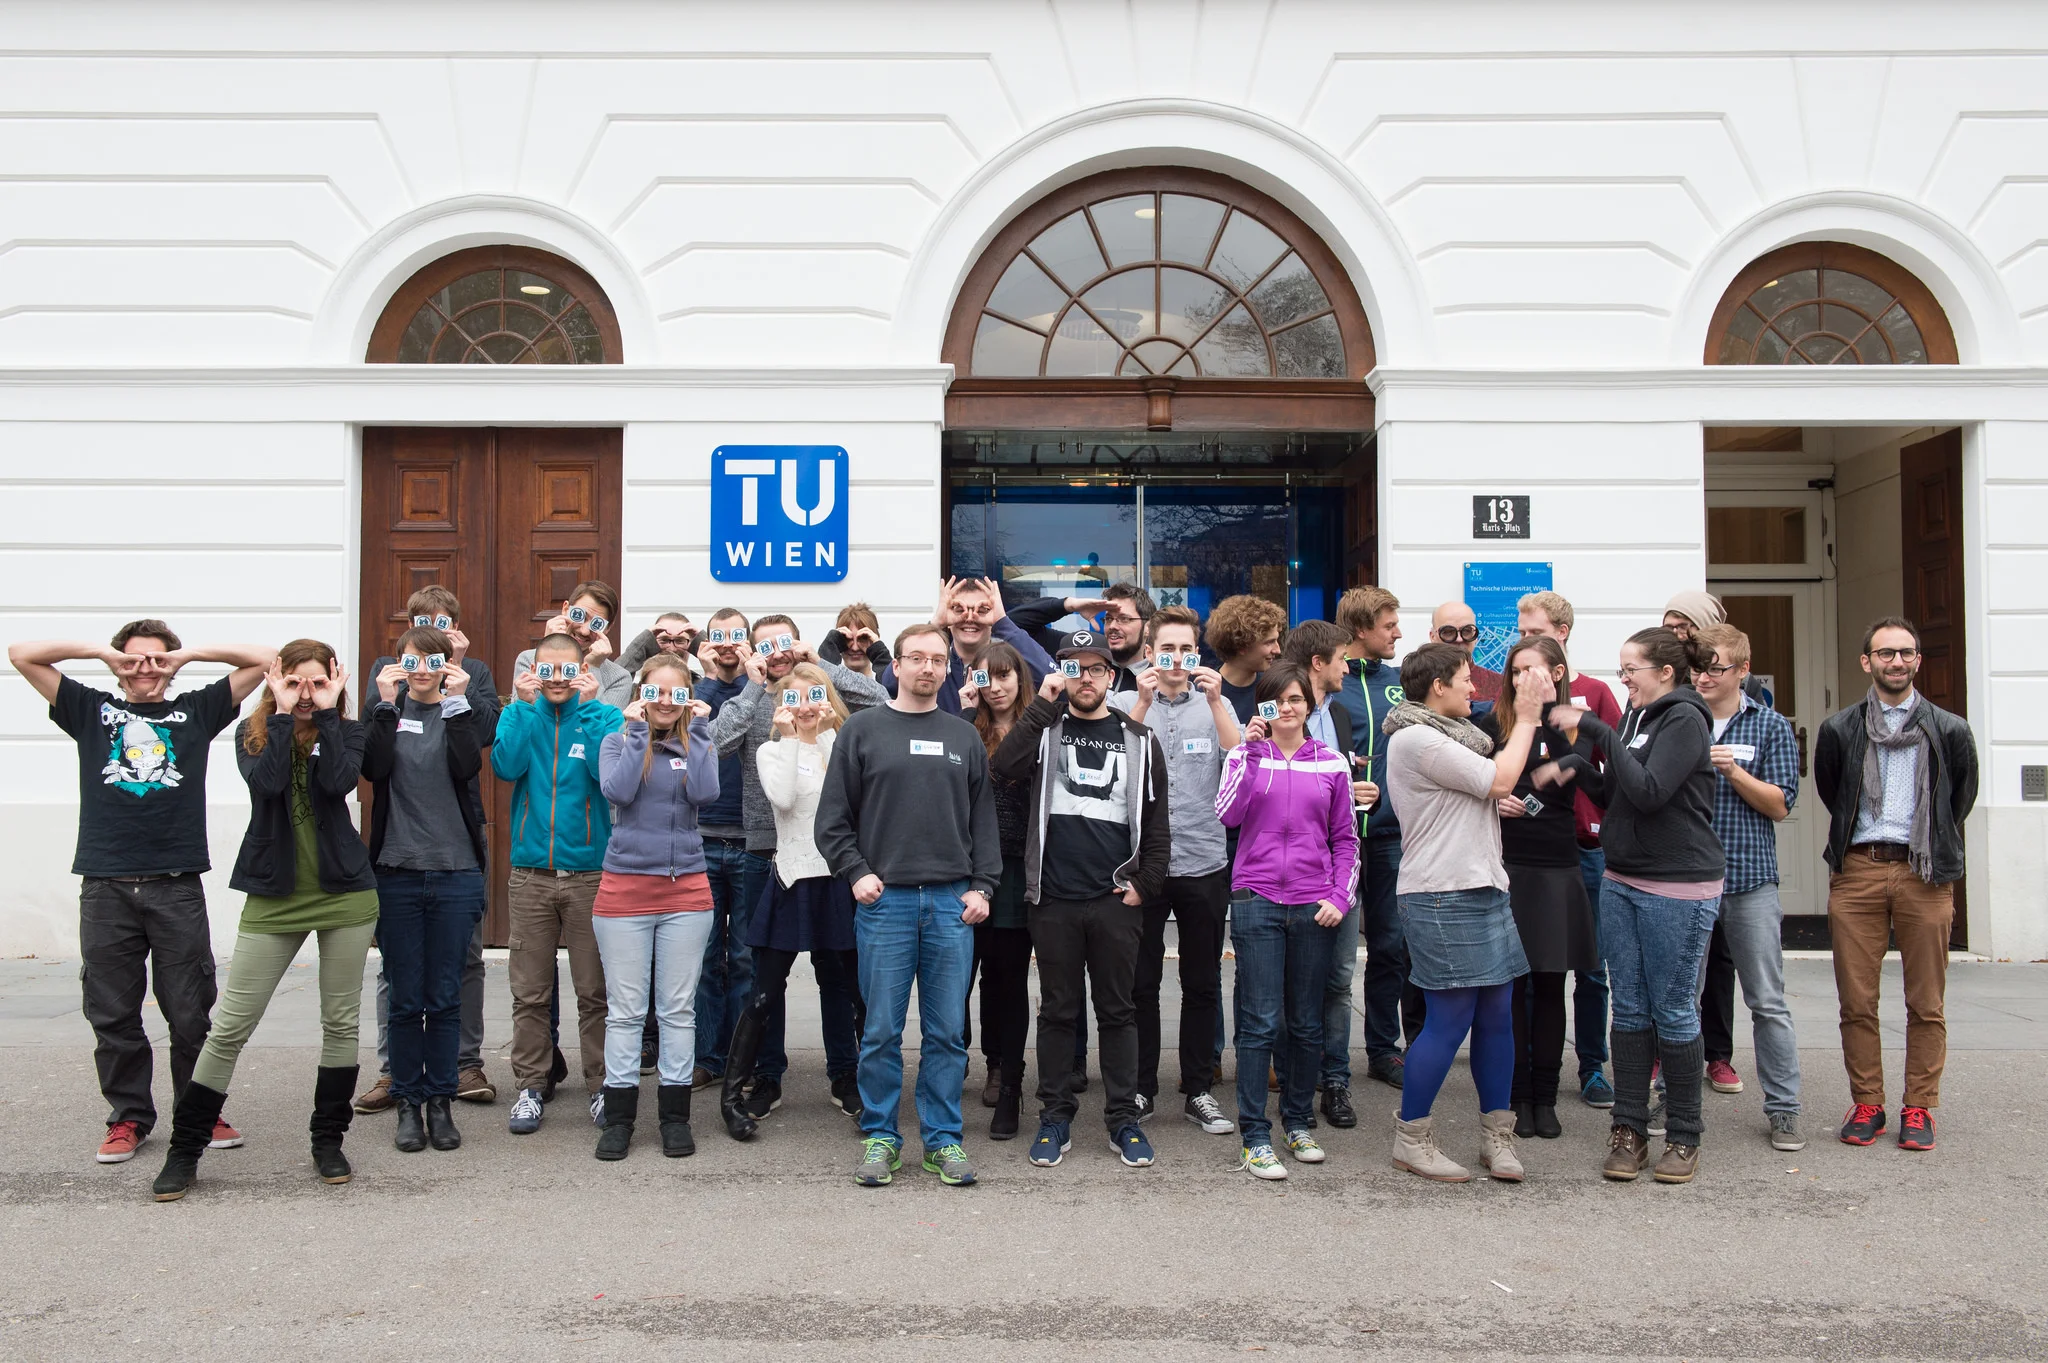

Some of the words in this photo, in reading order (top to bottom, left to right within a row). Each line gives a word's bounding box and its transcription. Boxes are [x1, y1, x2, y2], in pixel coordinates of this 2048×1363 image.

[724, 459, 836, 526] TU
[1488, 498, 1514, 523] 13
[724, 541, 836, 567] WIEN
[1073, 737, 1087, 746] AS
[1088, 740, 1103, 749] AN
[1105, 742, 1126, 751] OCE
[1196, 741, 1209, 749] FLO
